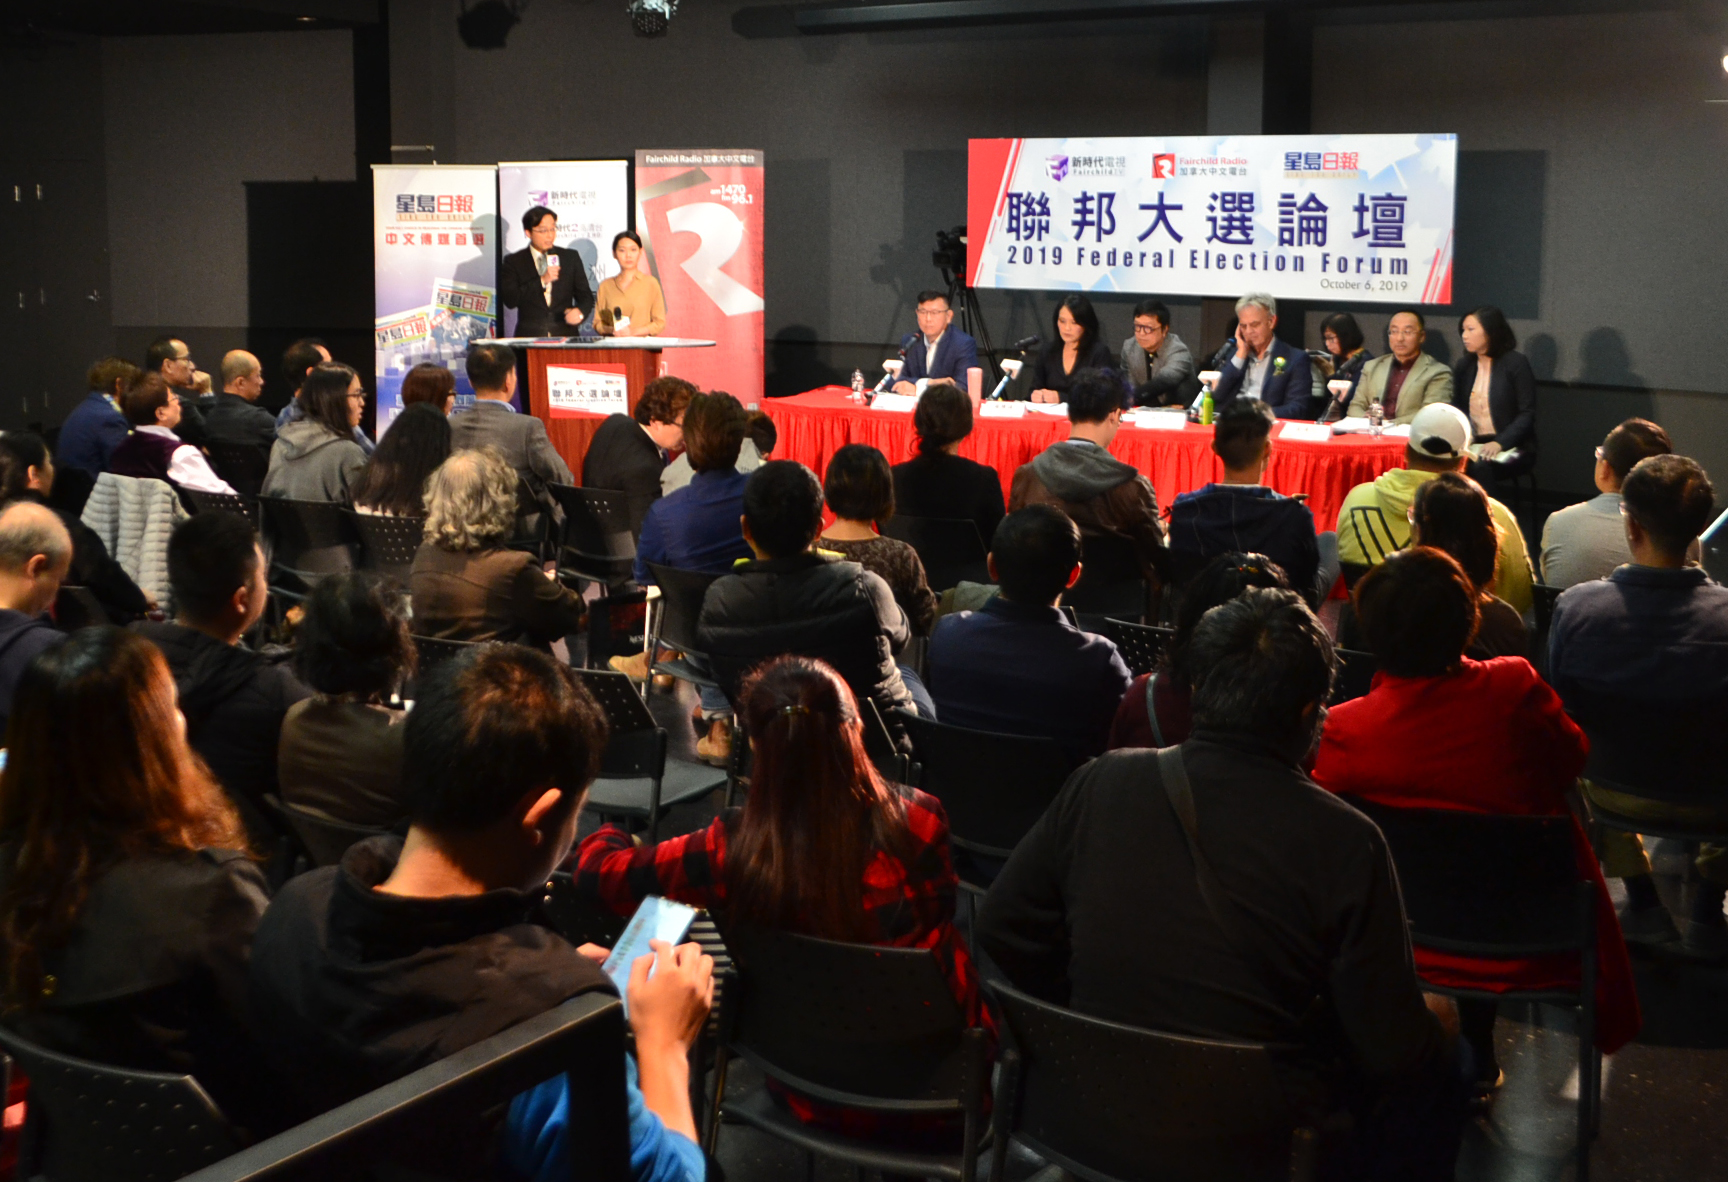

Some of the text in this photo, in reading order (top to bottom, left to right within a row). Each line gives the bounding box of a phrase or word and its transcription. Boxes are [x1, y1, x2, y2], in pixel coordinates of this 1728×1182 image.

[646, 155, 679, 164] Fairchild
[680, 155, 702, 164] Radio
[1071, 156, 1126, 168] 新時代電視
[1179, 156, 1248, 165] Fairchild Radio
[1284, 152, 1359, 171] 星島日報
[396, 194, 474, 213] 星島日報
[1006, 190, 1408, 249] 聯邦大選論壇
[1007, 246, 1408, 275] 2019 Federal Election Forum
[1320, 278, 1408, 292] October 6, 2019
